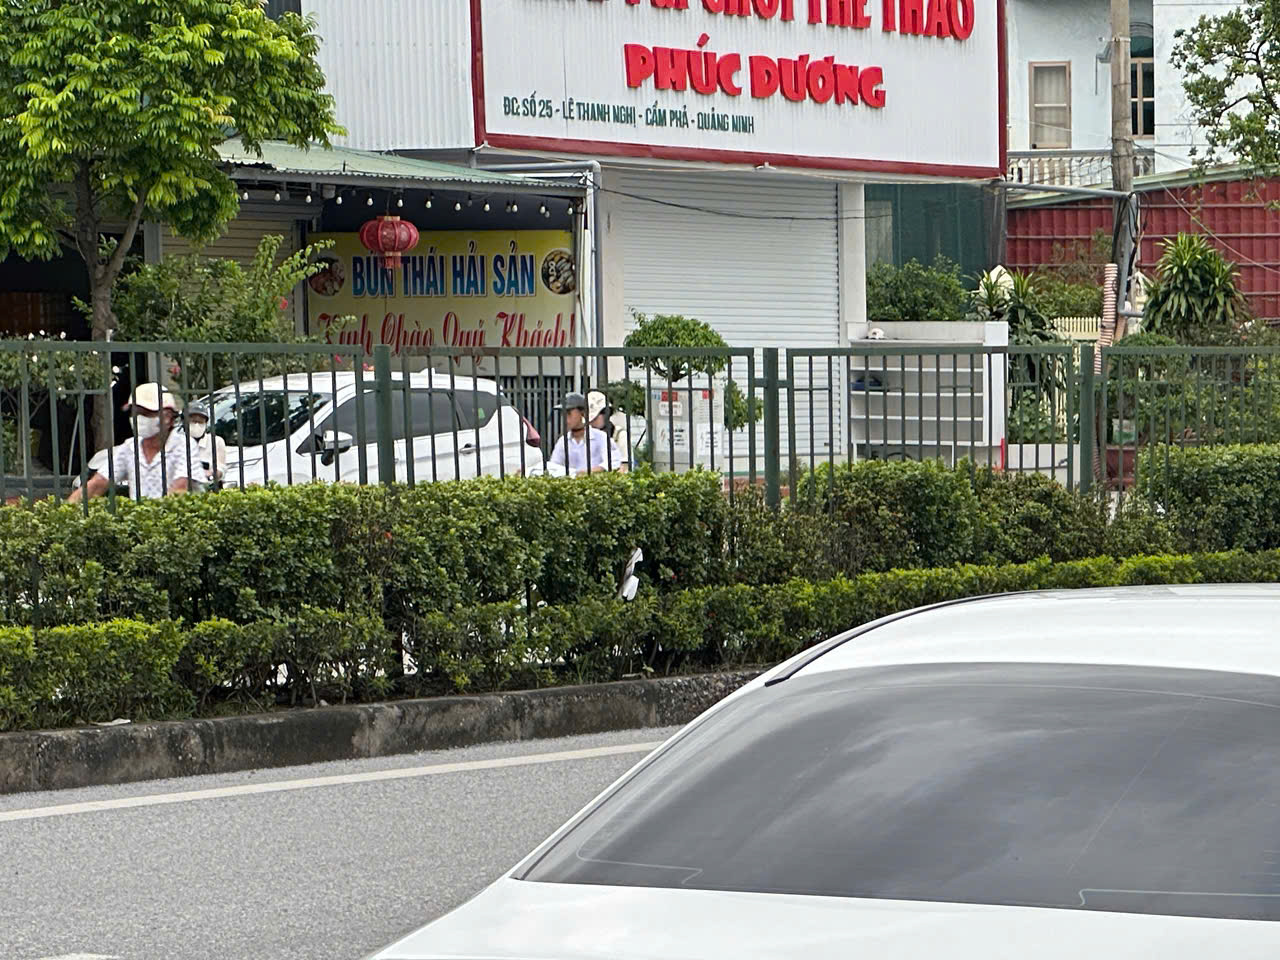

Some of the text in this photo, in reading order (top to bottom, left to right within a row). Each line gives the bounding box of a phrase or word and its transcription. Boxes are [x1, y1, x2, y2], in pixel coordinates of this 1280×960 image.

[624, 33, 886, 108] PHÚC DƯƠNG
[522, 90, 537, 117] SỐ
[539, 99, 553, 118] 25
[563, 97, 575, 120] LÊ
[576, 101, 611, 122] THANH
[612, 105, 636, 128] NGHỊ
[697, 107, 729, 132] QUẢNG
[731, 115, 754, 133] NINH
[352, 241, 534, 296] BÚN THÁI HẢI SẢN
